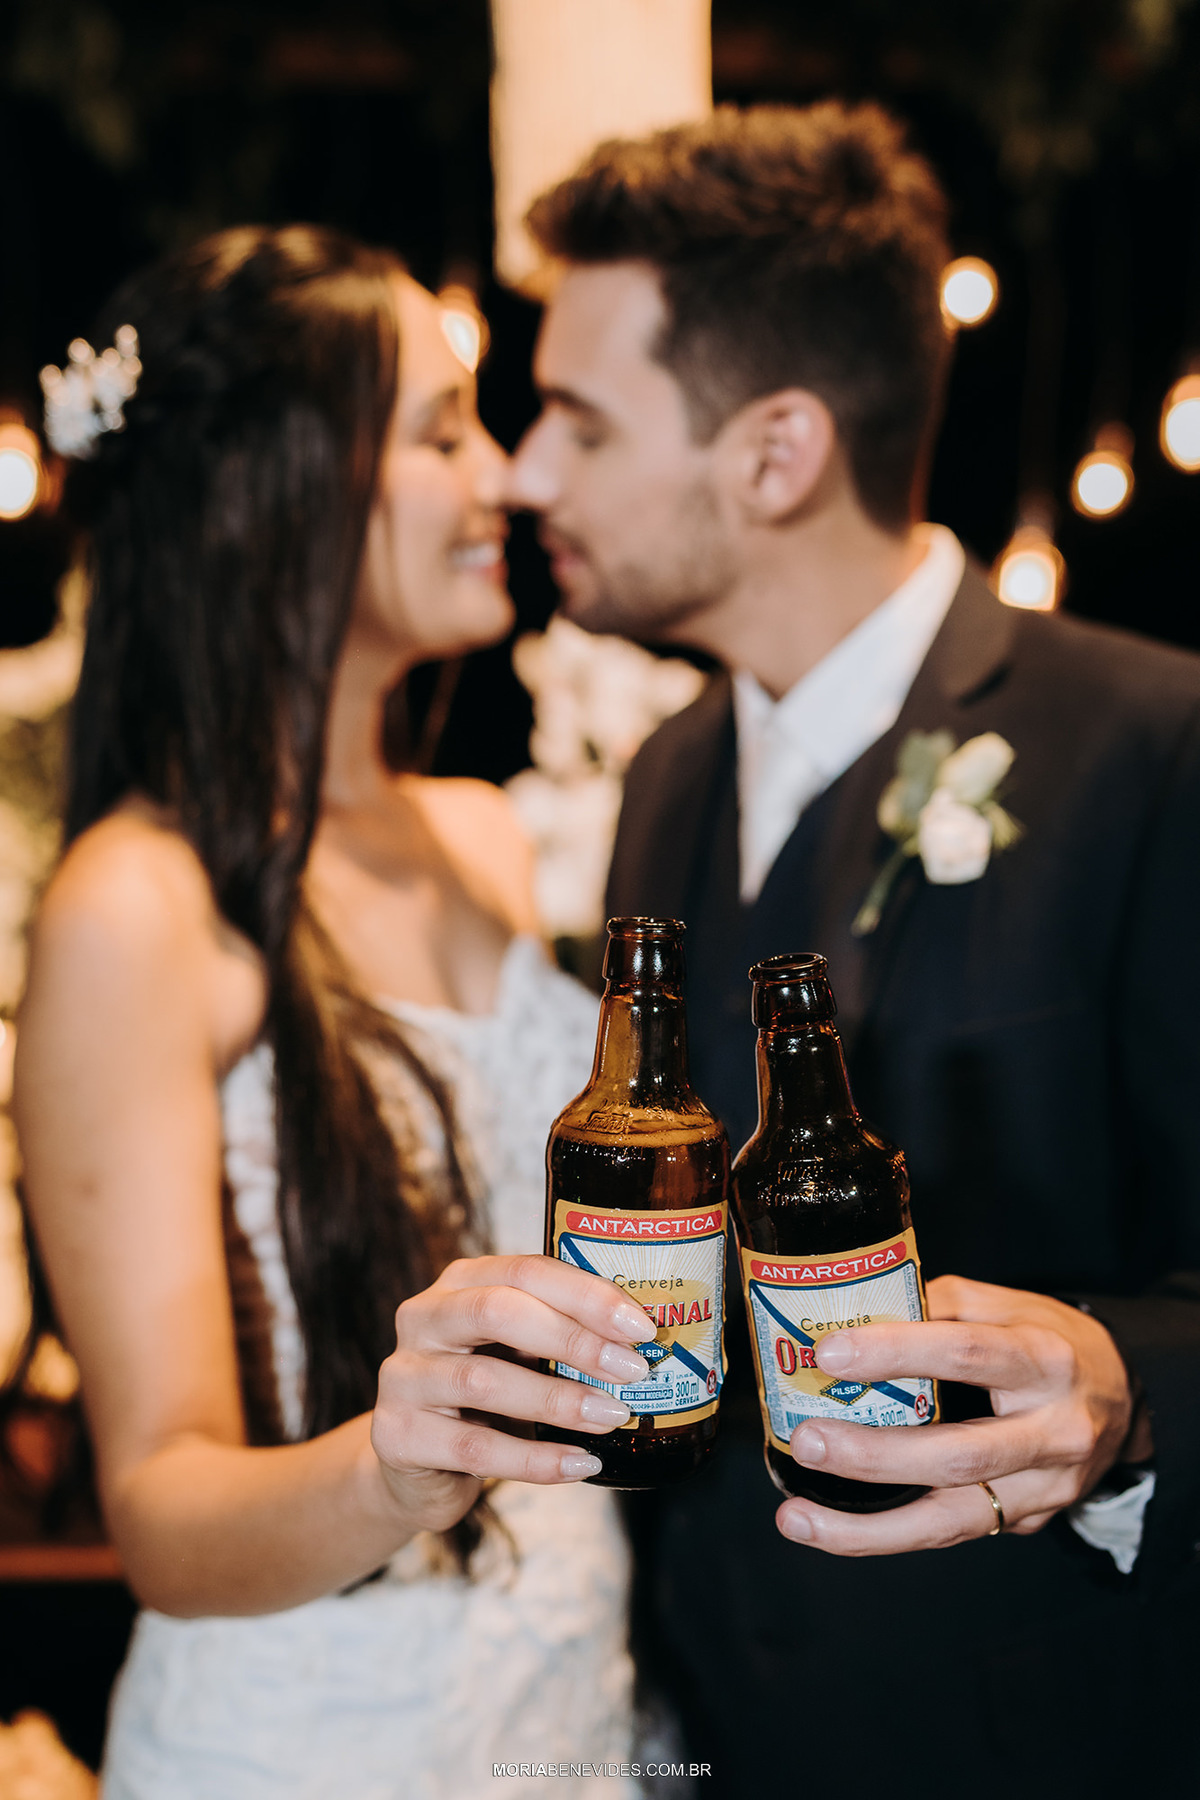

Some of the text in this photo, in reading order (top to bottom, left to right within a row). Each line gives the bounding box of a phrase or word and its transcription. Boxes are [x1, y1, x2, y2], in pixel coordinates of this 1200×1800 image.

[578, 1215, 715, 1235] ANTARCTICA
[761, 1249, 898, 1280] ANTARCTICA
[612, 1274, 684, 1290] Cerveja
[642, 1296, 713, 1328] GINAL
[800, 1313, 872, 1332] Cerveja
[638, 1349, 664, 1358] ILSEN
[675, 1380, 690, 1398] 300
[830, 1384, 862, 1396] PILSEN
[675, 1395, 700, 1407] CERVEJA
[880, 1409, 896, 1427] 300
